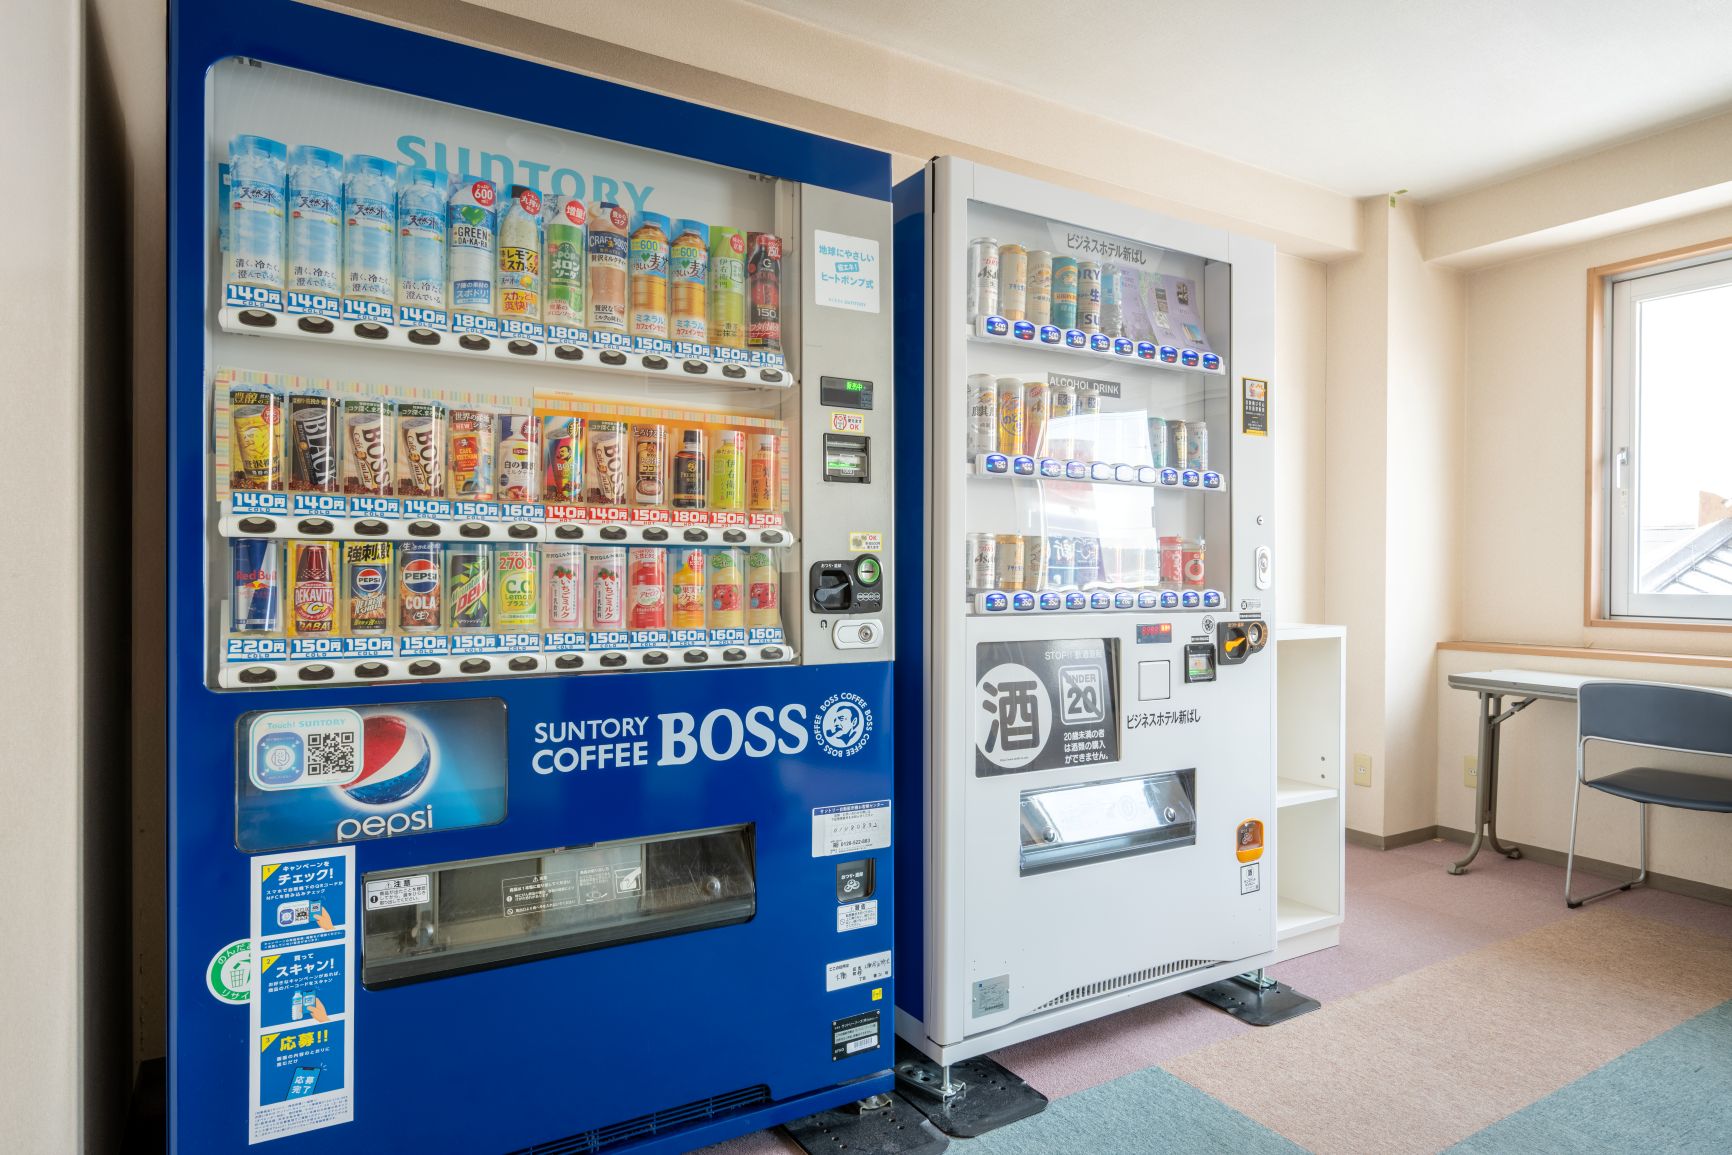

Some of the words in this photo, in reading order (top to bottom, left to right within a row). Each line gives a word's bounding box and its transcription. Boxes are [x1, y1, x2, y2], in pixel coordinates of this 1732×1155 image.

[474, 190, 493, 200] 600
[458, 226, 488, 240] GREEN
[640, 240, 658, 251] 600
[681, 247, 698, 258] 600
[1067, 232, 1147, 265] ビジネスホテル新ばし
[819, 244, 874, 263] 地球にやさしい
[821, 272, 874, 289] ヒートポンプ式
[228, 285, 280, 304] 140円
[290, 293, 338, 311] 140円
[345, 299, 391, 317] 140円
[402, 307, 446, 324] 140円
[757, 308, 776, 318] 150
[454, 313, 497, 330] 180円
[502, 319, 543, 335] 180円
[548, 325, 588, 341] 180円
[594, 331, 631, 347] 190円
[636, 337, 671, 352] 150円
[676, 341, 710, 356] 150円
[752, 351, 784, 364] 210円
[1093, 382, 1119, 395] DRINK
[850, 423, 859, 431] OK
[235, 493, 285, 507] 140円
[296, 496, 345, 510] 140円
[352, 498, 398, 512] 140円
[405, 501, 449, 514] 140円
[457, 503, 498, 515] 150円
[236, 570, 257, 581] Red
[405, 572, 437, 580] PEPSI
[295, 587, 334, 605] DEKAVITA
[406, 597, 437, 609] COLA
[561, 579, 571, 618] いちごミルク
[605, 581, 614, 619] いちごミルク
[306, 602, 323, 614] C
[346, 638, 391, 650] 150円
[403, 637, 447, 649] 150円
[454, 636, 496, 647] 150円
[499, 634, 539, 646] 150円
[546, 633, 585, 644] 150円
[591, 632, 627, 643] 150円
[230, 639, 284, 653] 220円
[293, 639, 341, 651] 150円
[820, 694, 840, 711] BOSS
[841, 692, 868, 709] COFFEE
[1067, 686, 1097, 715] 20
[267, 721, 295, 729] Touch!
[298, 718, 345, 728] SUNTORY
[865, 709, 874, 731] BOSS
[982, 680, 1040, 754] 酒
[1127, 707, 1201, 729] ビジネスホテル新ばし
[535, 716, 649, 744] SUNTORY
[656, 703, 809, 766] BOSS
[814, 714, 825, 746] COFFEE
[1063, 728, 1105, 742] 20歳未満の者
[824, 745, 845, 758] BOSS
[846, 733, 871, 757] COFFEE
[1064, 740, 1106, 753] は酒類の購入
[532, 741, 648, 775] COFFEE
[1065, 751, 1109, 765] ができません。
[337, 804, 434, 843] pepsi
[282, 861, 330, 872] キャンペーンを
[278, 868, 334, 886] チェック!
[294, 953, 314, 962] 買って
[276, 958, 334, 979] スキャン!
[295, 1076, 314, 1084] 応募
[291, 1085, 311, 1094] 完了
